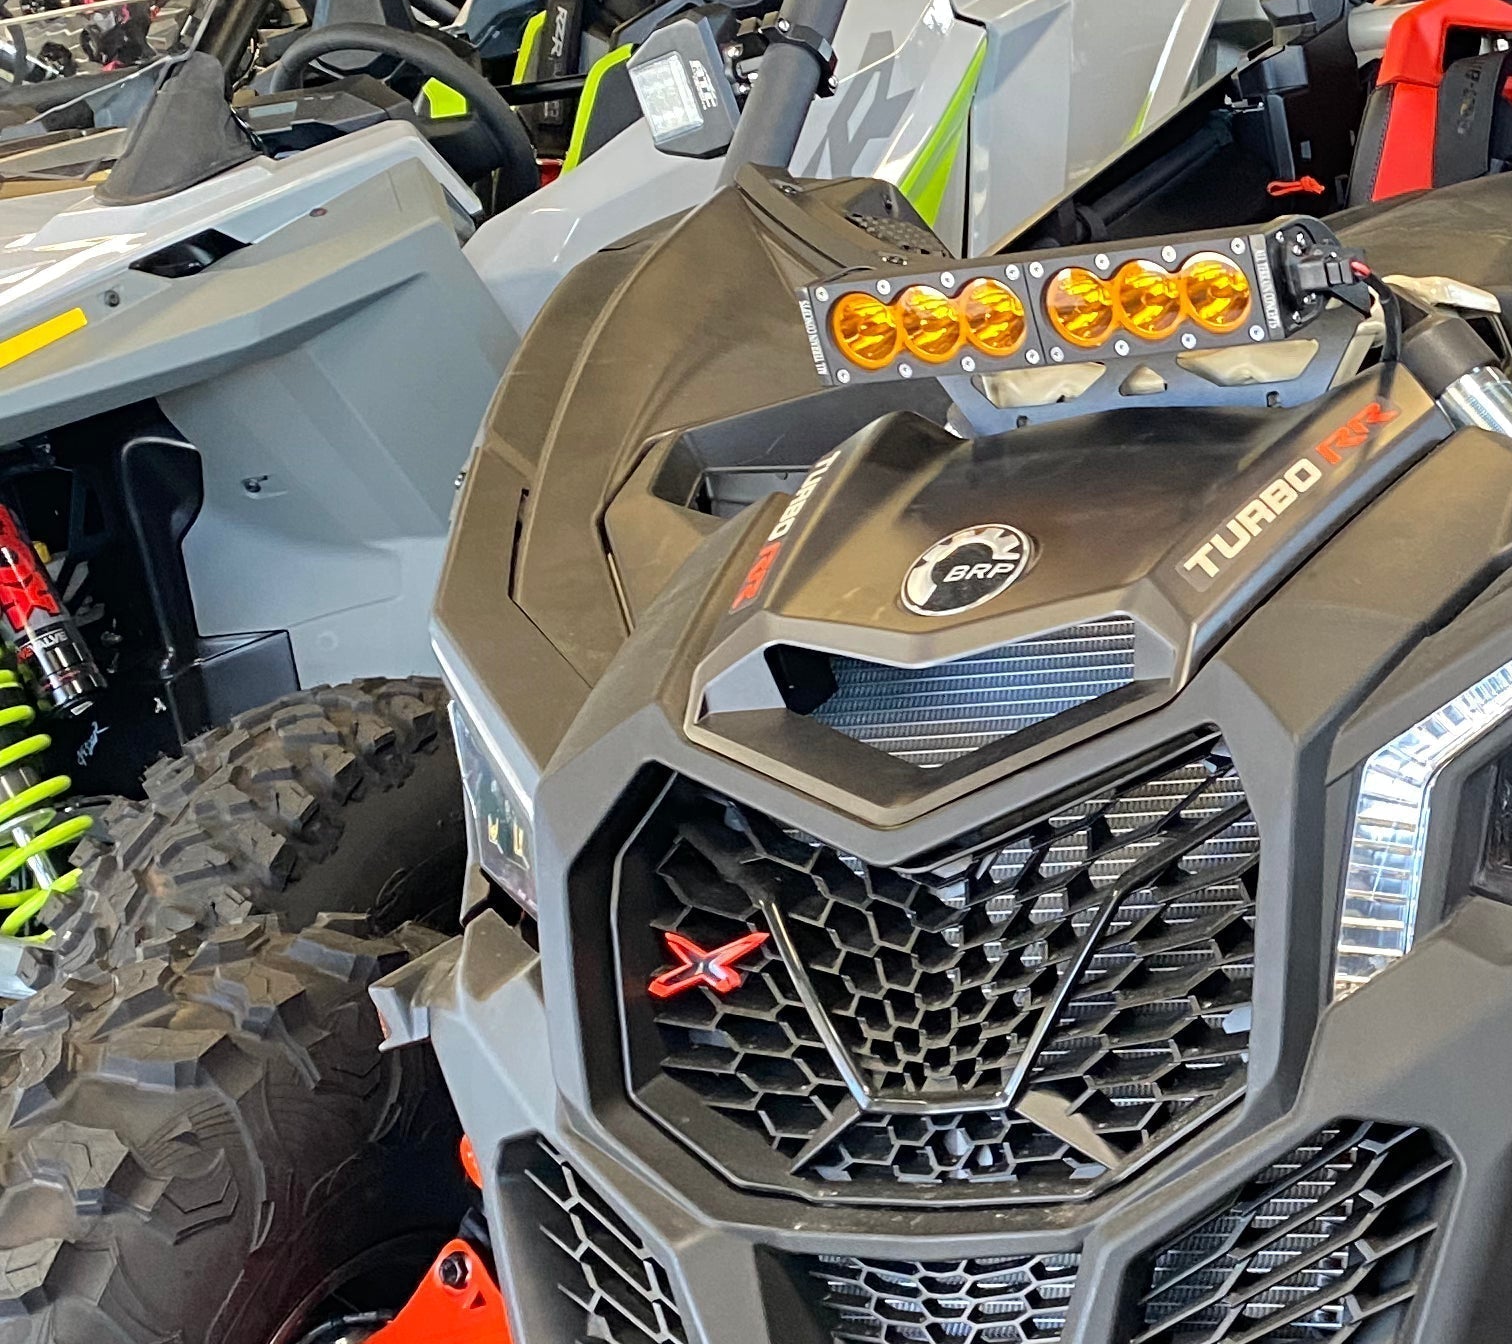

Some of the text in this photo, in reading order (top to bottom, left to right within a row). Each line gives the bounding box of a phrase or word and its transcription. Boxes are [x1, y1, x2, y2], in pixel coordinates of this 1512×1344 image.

[815, 361, 829, 376] ALL
[767, 450, 842, 542] TURBO
[1183, 457, 1322, 578] TURBO
[943, 560, 1016, 585] BRP
